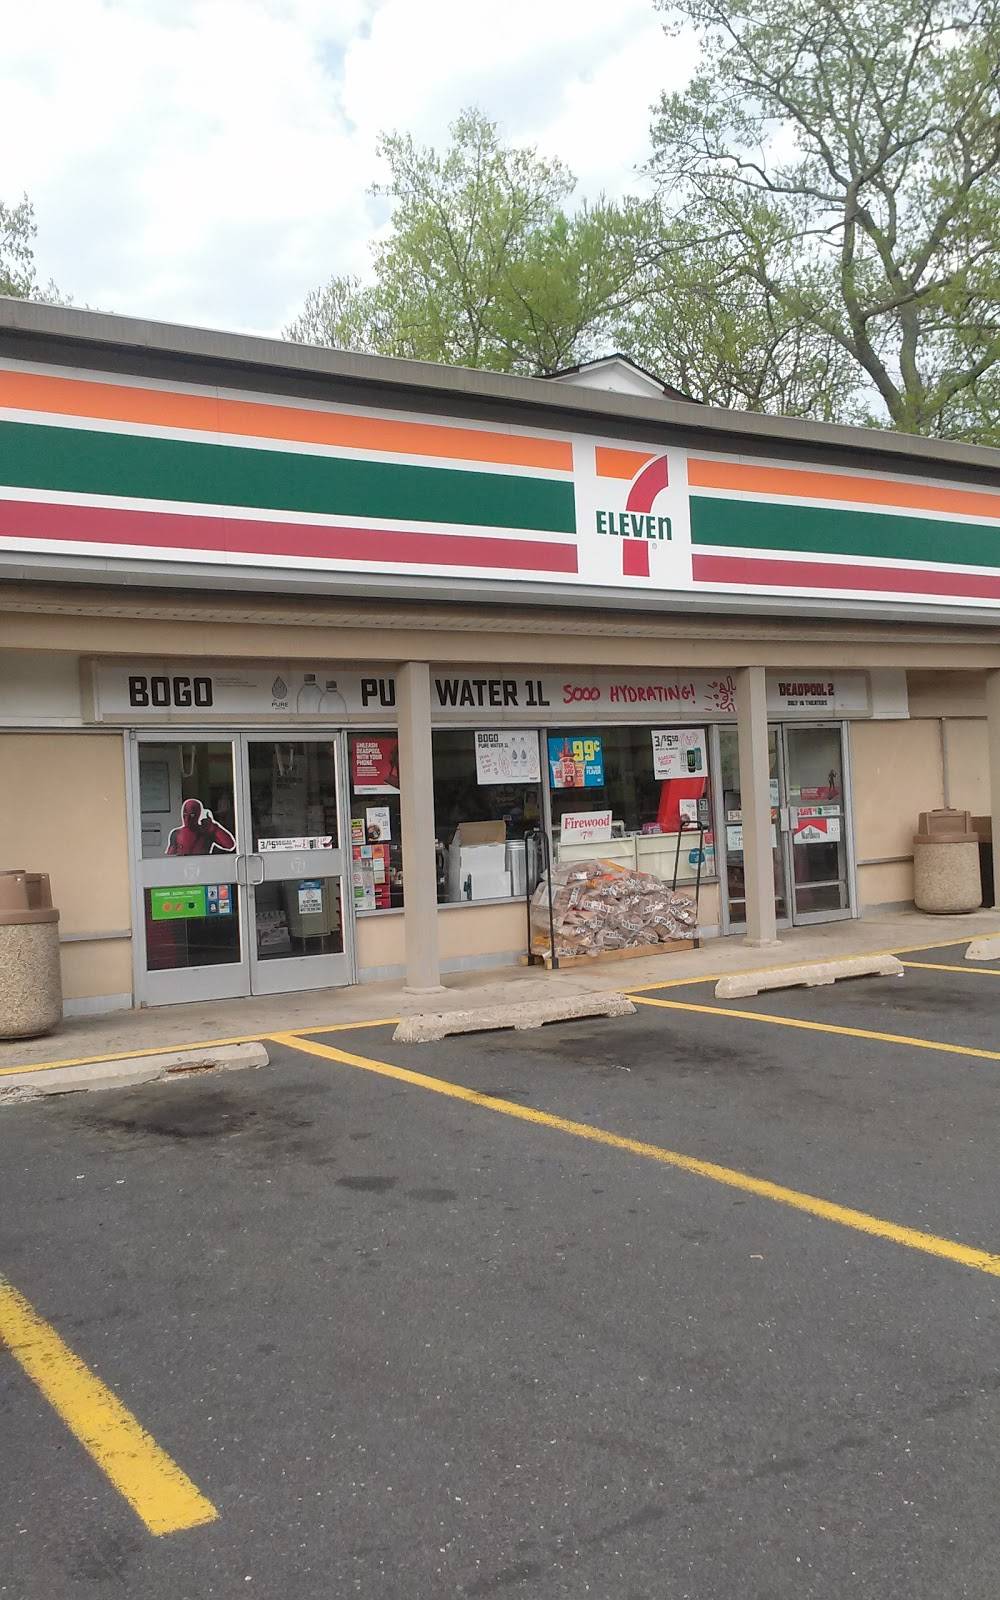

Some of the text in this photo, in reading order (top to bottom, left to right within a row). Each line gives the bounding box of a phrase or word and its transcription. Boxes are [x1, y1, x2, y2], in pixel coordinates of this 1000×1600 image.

[128, 676, 213, 707] BOGO
[435, 679, 519, 706] WATER
[525, 680, 550, 706] 1L
[610, 683, 696, 704] HYDRATING!
[778, 682, 835, 696] DEADPOOL 2
[478, 733, 499, 743] BOGO
[564, 814, 610, 829] Firewood
